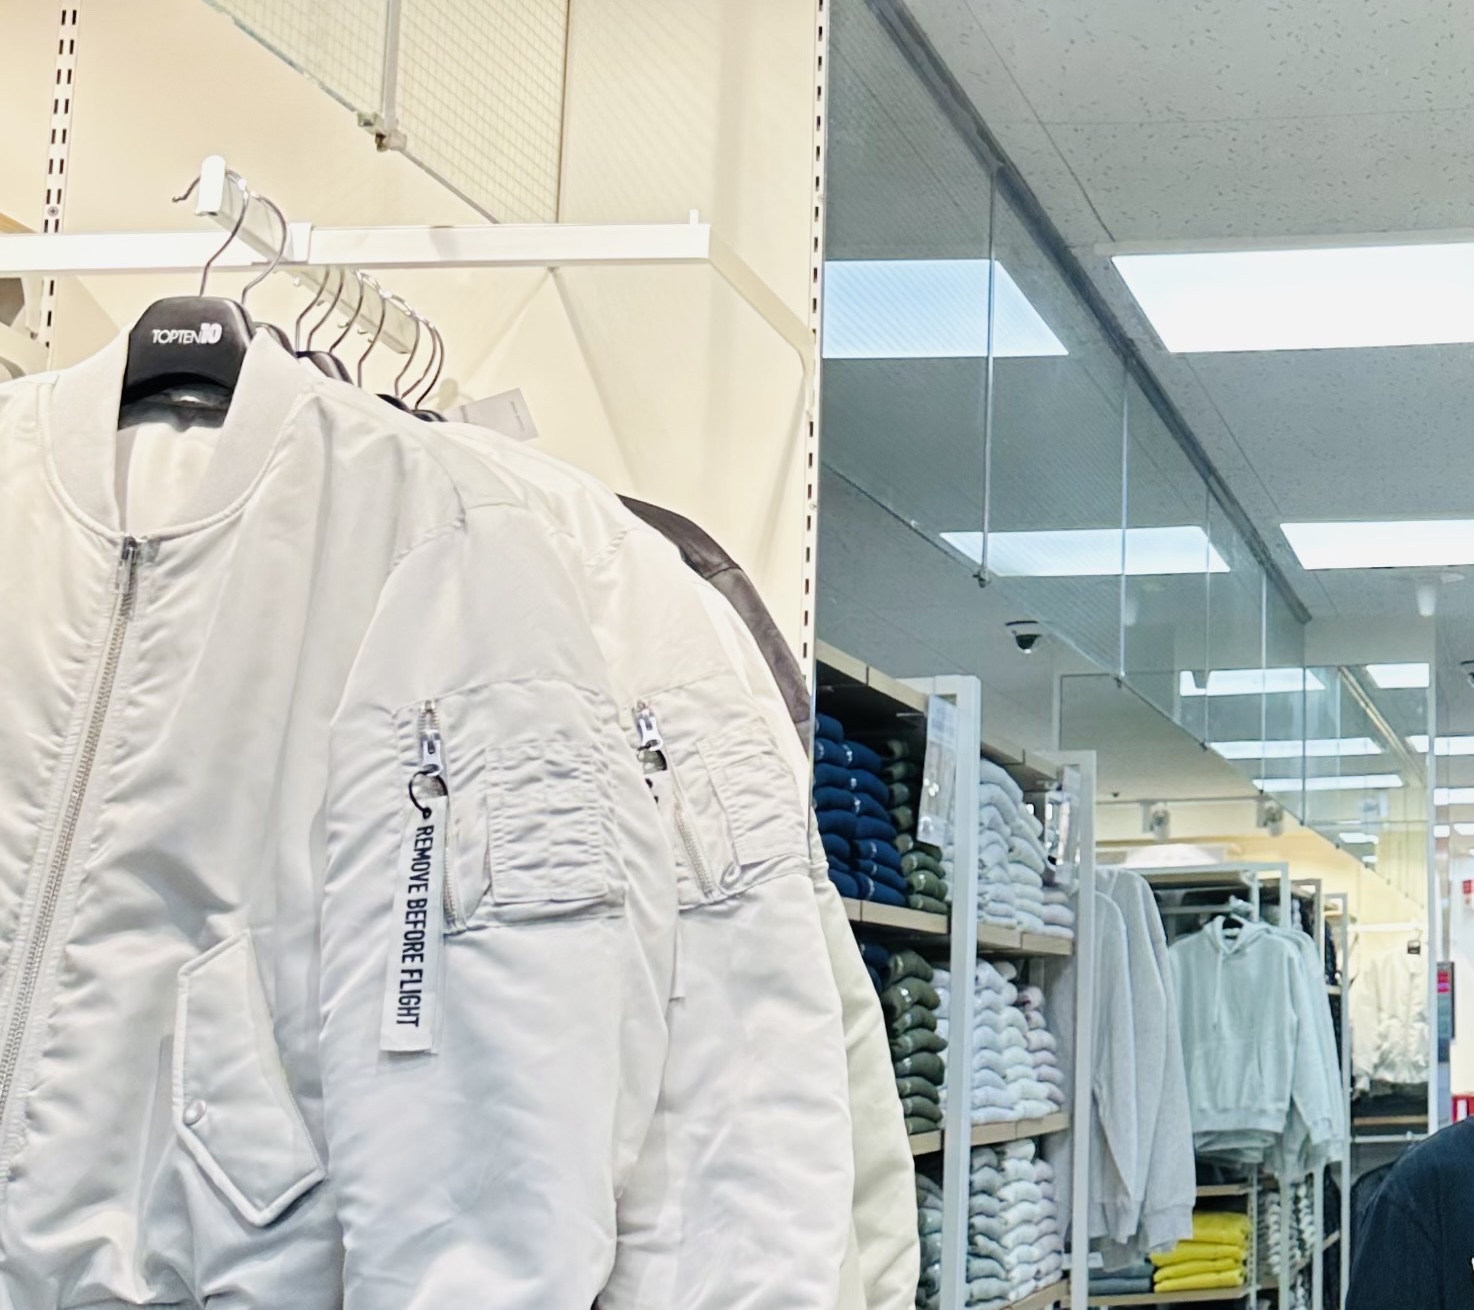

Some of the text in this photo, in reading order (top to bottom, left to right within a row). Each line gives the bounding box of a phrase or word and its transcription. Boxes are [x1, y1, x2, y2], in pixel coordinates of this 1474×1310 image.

[396, 824, 435, 1028] REMOVE BEFORE FLIGHT
